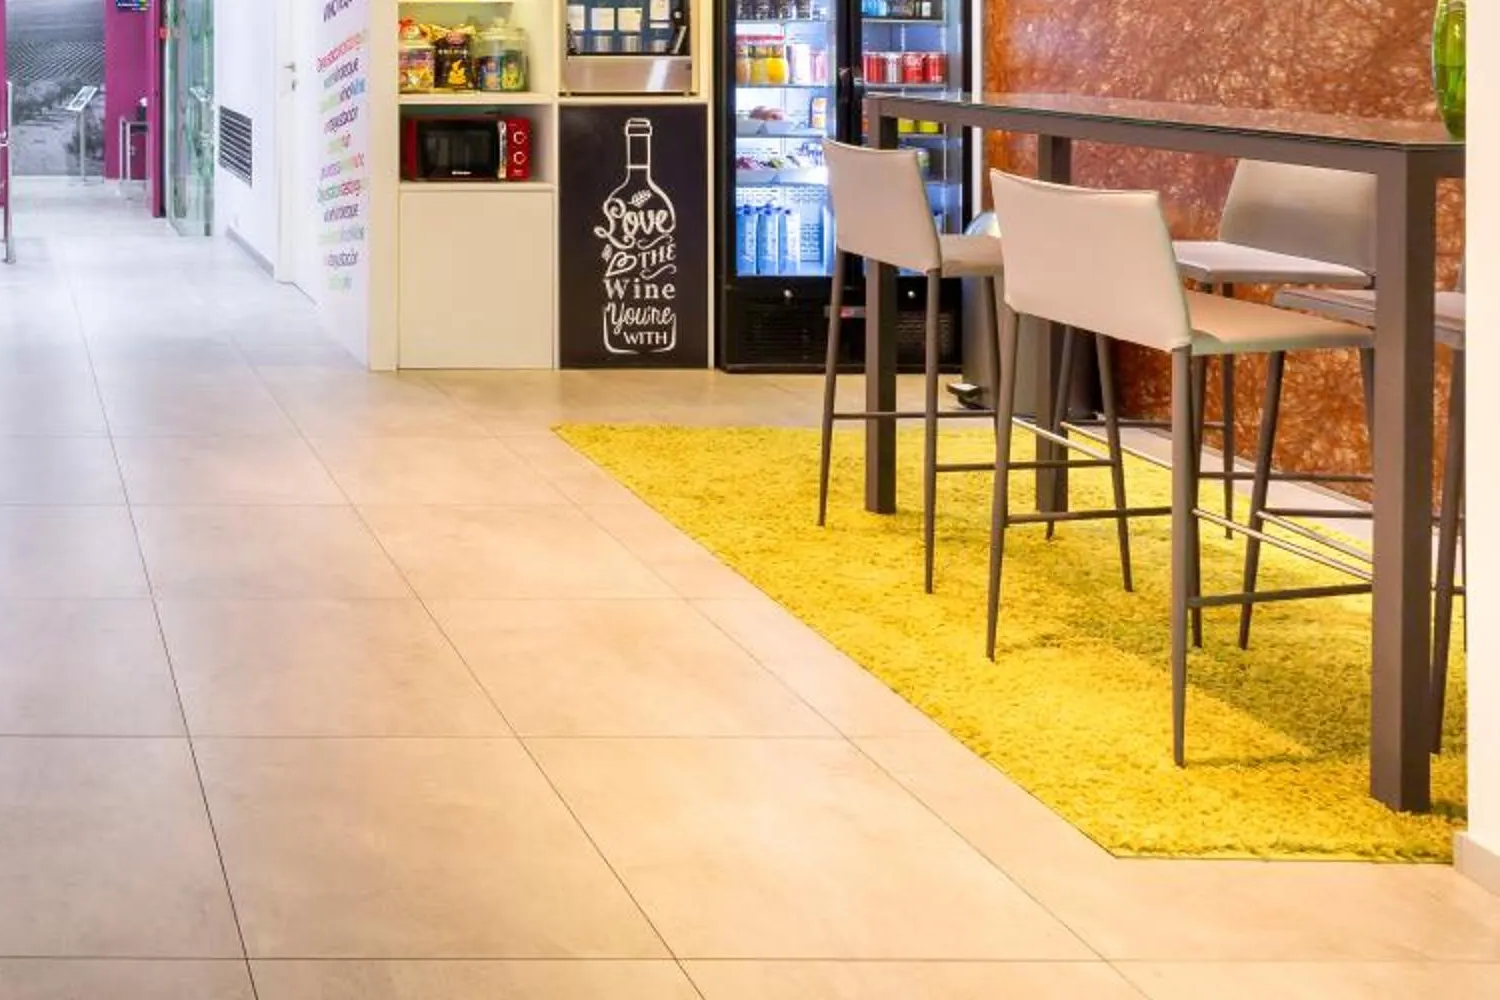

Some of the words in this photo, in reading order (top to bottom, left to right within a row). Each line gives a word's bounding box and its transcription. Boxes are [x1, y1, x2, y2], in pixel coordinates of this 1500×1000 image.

[594, 198, 672, 249] Love
[638, 243, 676, 270] THE
[603, 278, 676, 300] Wine
[623, 331, 668, 346] WITH
